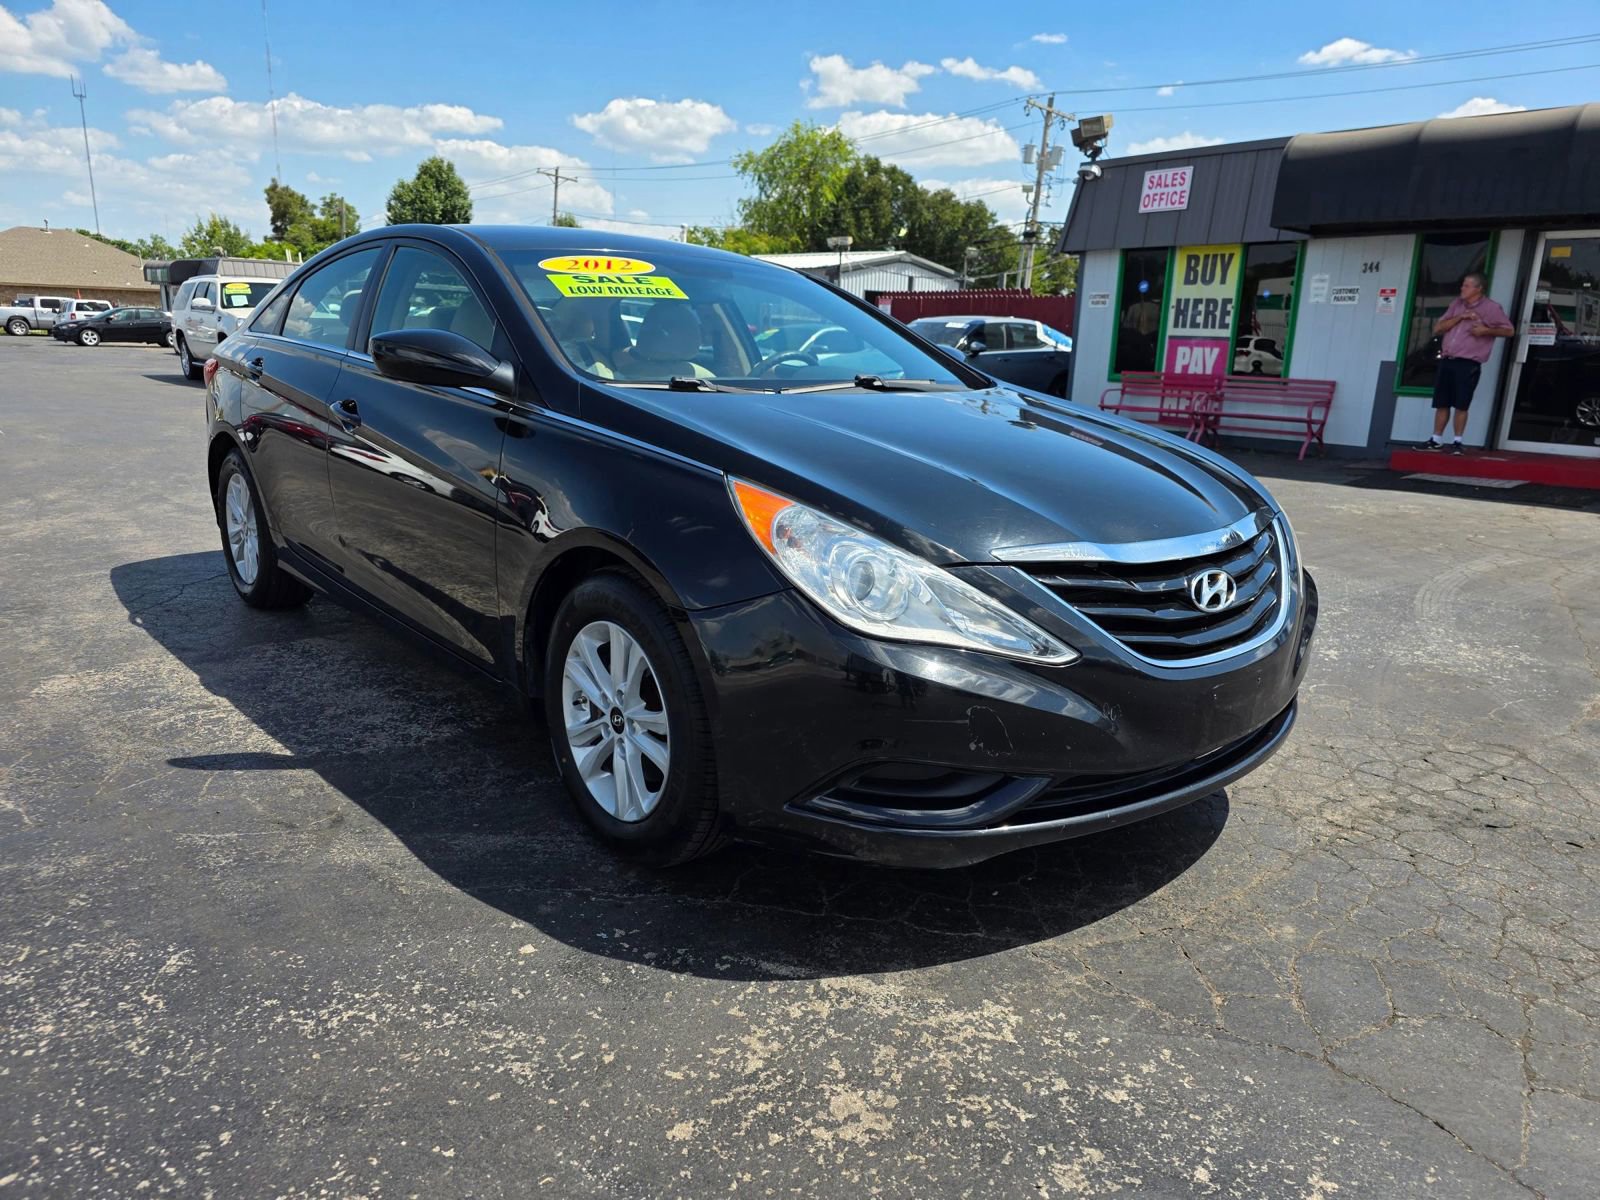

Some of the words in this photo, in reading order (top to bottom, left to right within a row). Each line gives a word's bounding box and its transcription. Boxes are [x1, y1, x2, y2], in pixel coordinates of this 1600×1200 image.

[1147, 171, 1187, 190] SALES
[1142, 190, 1187, 209] OFFICE
[567, 259, 633, 270] 2012
[1183, 252, 1235, 286] BUY
[1362, 261, 1380, 274] 344
[572, 275, 654, 285] SALE
[568, 285, 603, 295] LOW
[607, 286, 675, 296] MILEAGE
[1332, 287, 1360, 295] CUSTOMER
[1173, 298, 1234, 329] HERE
[1173, 346, 1220, 375] PAY
